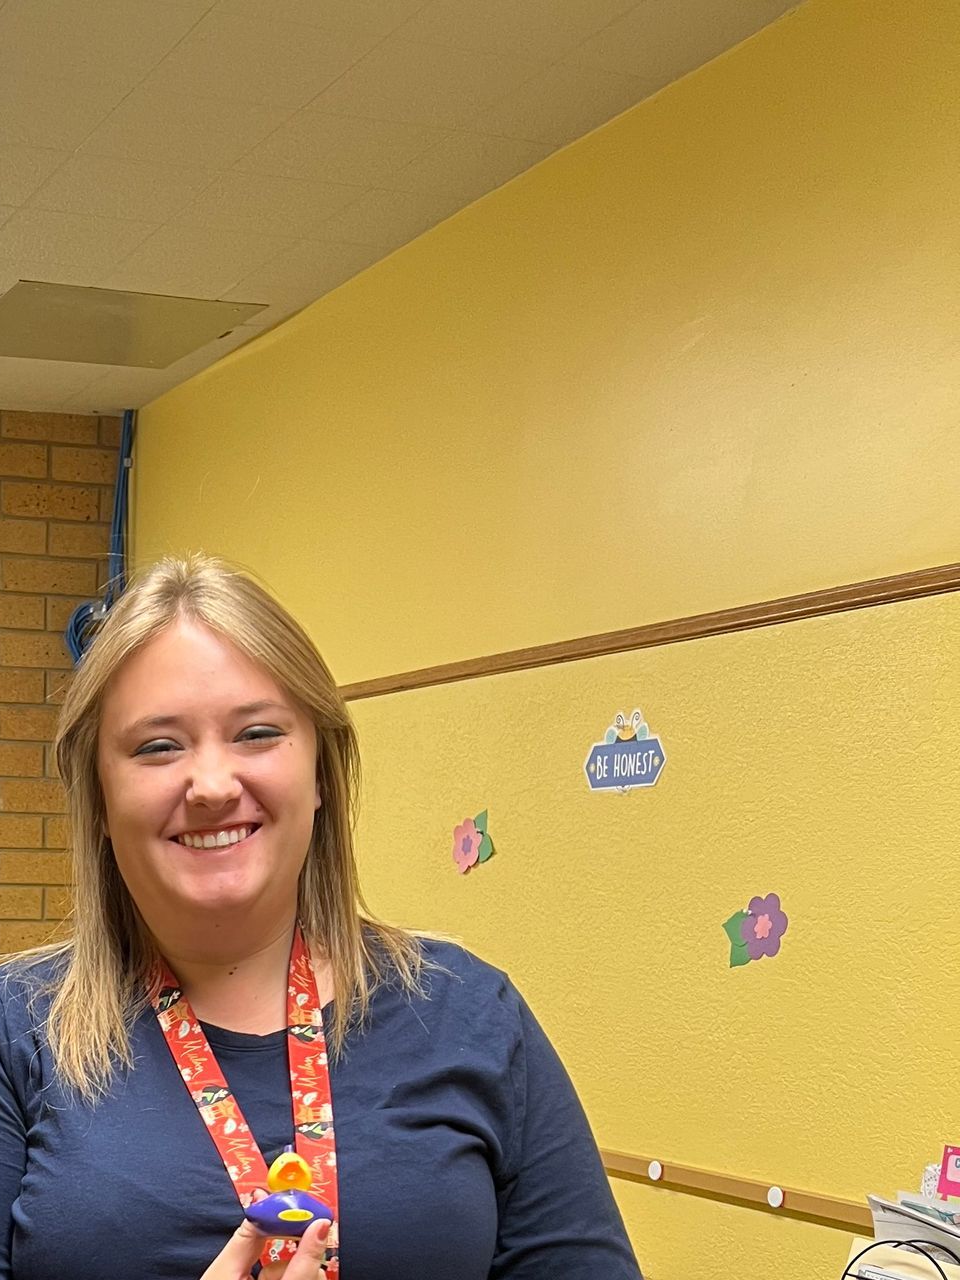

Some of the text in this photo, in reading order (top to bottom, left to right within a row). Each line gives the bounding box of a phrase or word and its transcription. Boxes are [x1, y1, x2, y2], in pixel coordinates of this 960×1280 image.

[596, 750, 655, 780] BE HONEST
[175, 1039, 208, 1080] Mulan
[296, 1052, 322, 1090] Mulan
[218, 1135, 256, 1178] Mulan
